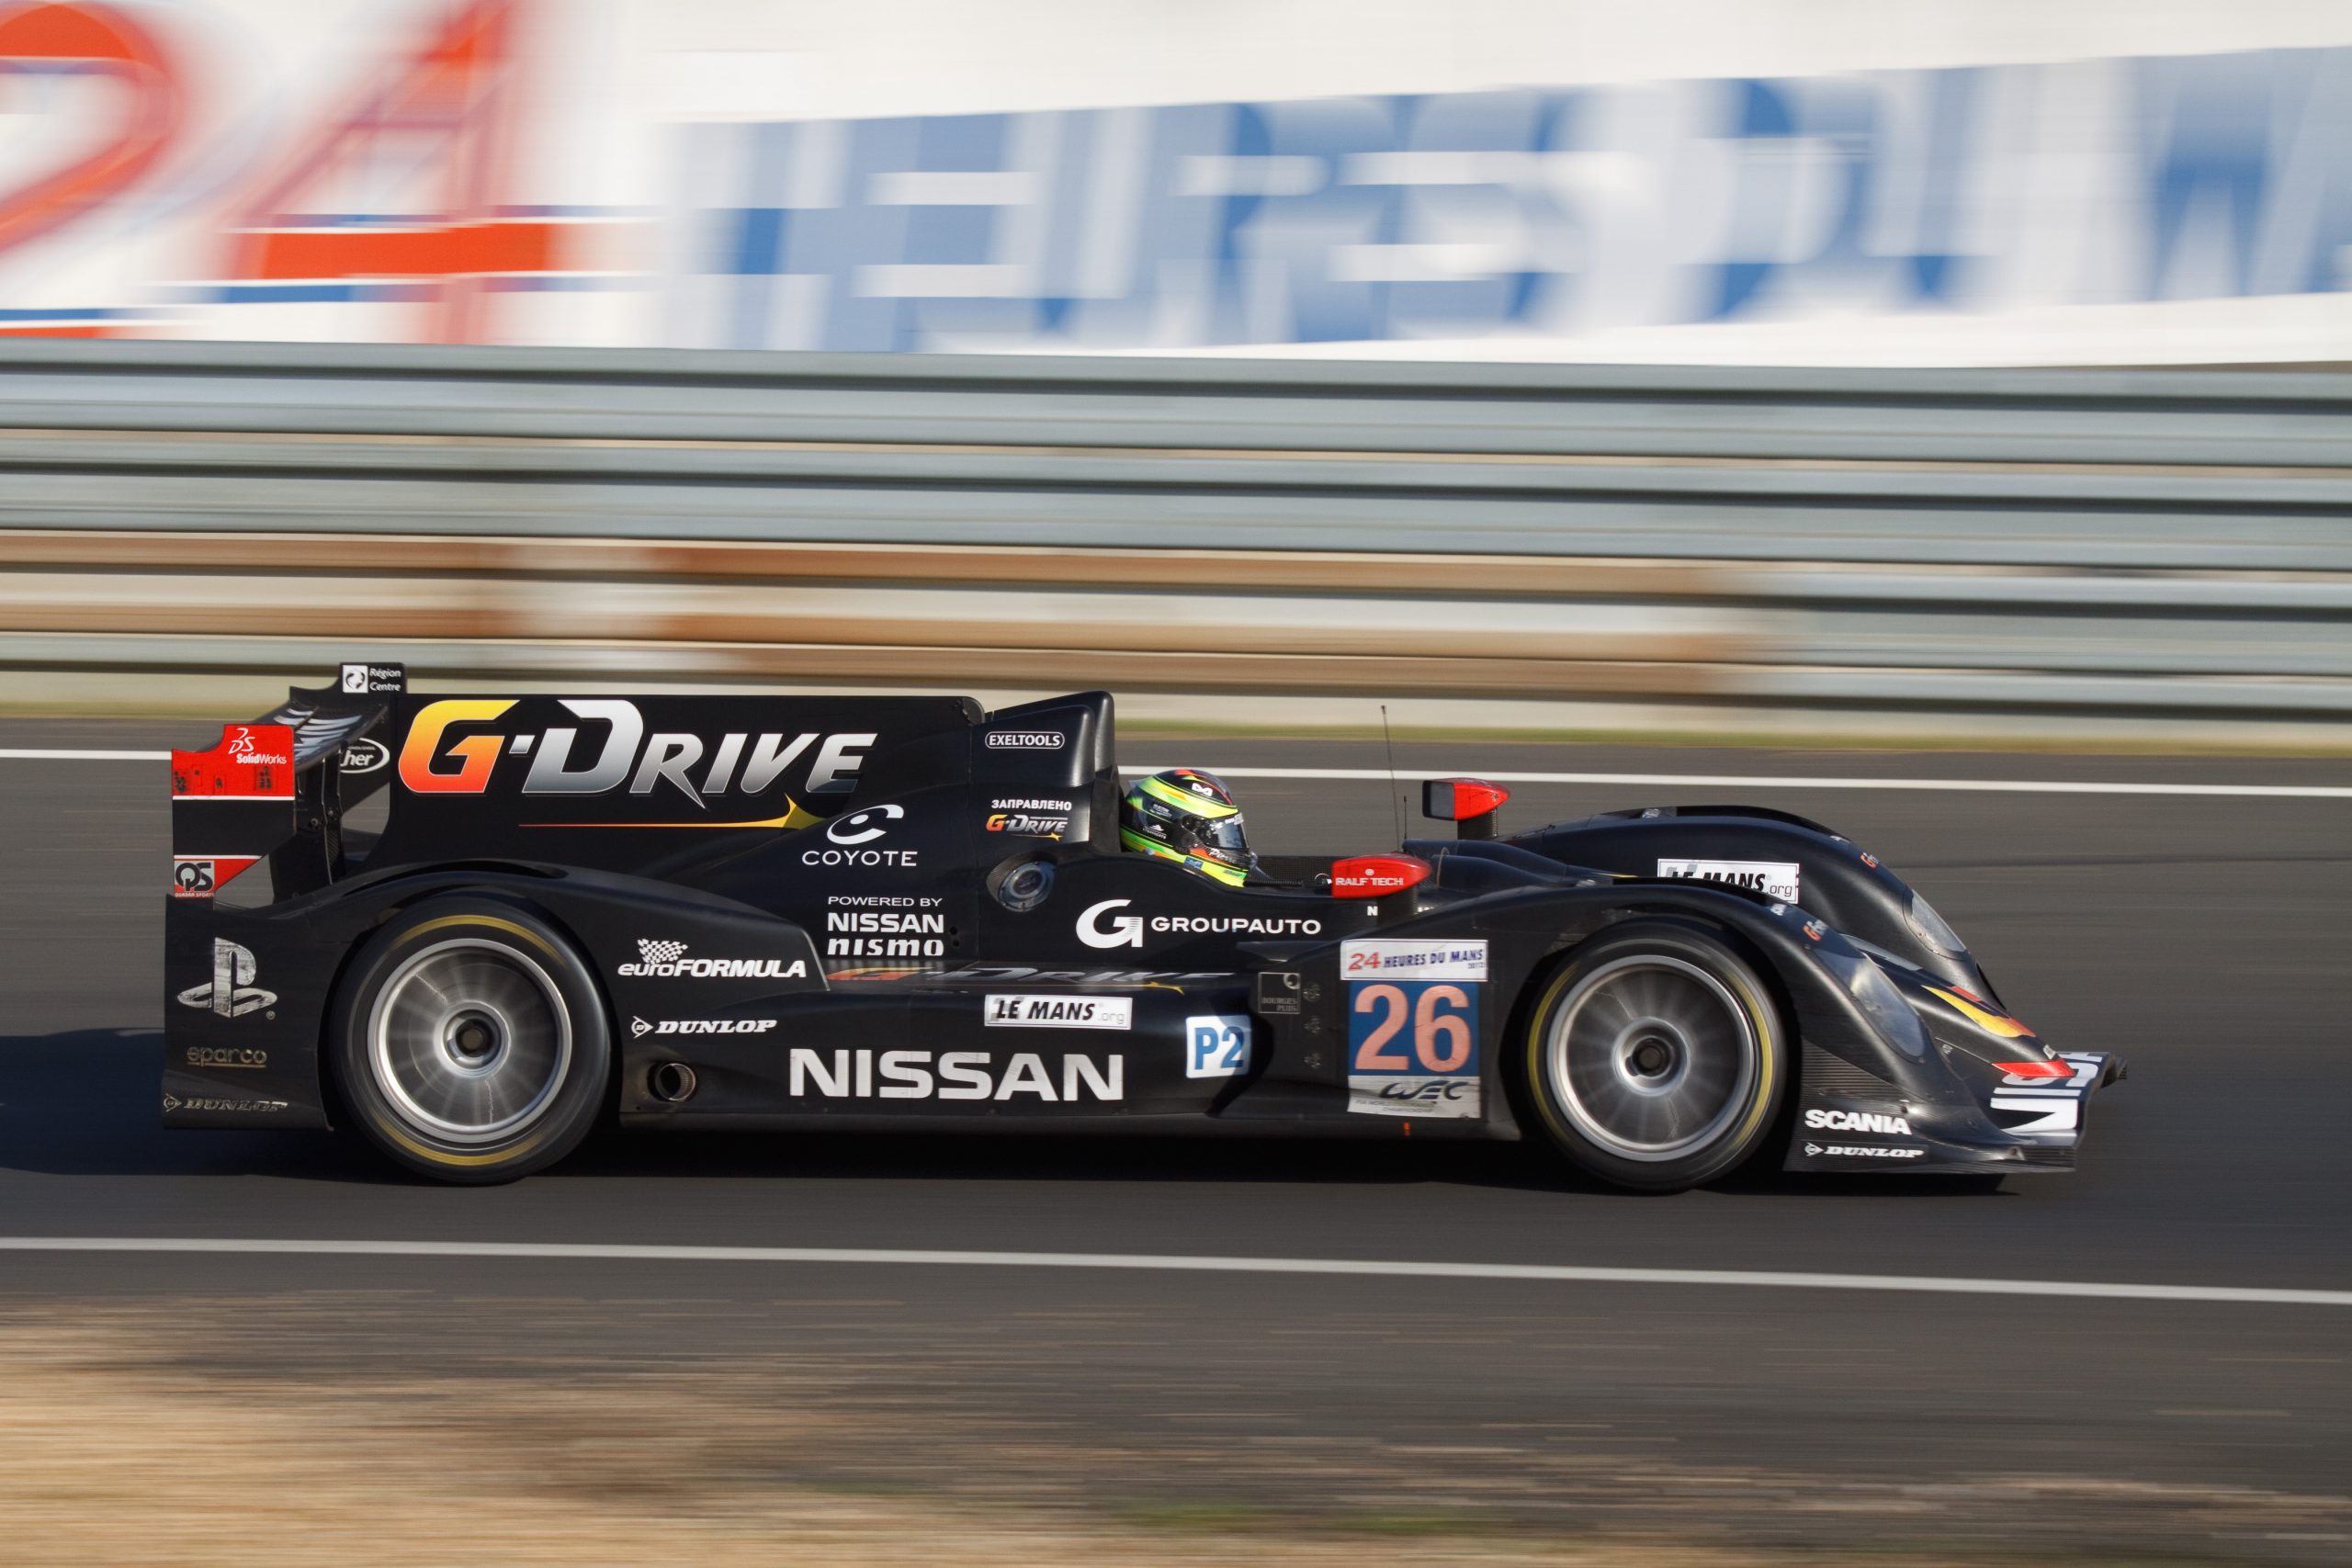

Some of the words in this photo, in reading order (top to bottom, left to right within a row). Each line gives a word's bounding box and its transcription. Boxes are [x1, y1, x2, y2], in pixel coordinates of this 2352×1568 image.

[369, 668, 401, 679] Région
[369, 682, 401, 692] Centre
[989, 735, 1060, 747] EXELTOOLS
[236, 752, 288, 764] SolidWorks
[398, 699, 878, 809] G-DRIVE
[991, 799, 1073, 811] ЗАПРАВЛЕНО
[986, 814, 1069, 834] G-DRIVE
[801, 851, 918, 867] COYOTE
[1336, 877, 1369, 886] RALF
[1370, 877, 1404, 886] TECH
[828, 896, 914, 907] POWERED
[920, 898, 943, 907] BY
[827, 912, 944, 933] NISSAN
[1151, 917, 1321, 935] GROUPAUTO
[827, 939, 944, 956] nismo
[617, 959, 807, 977] euroFORMULA
[1348, 952, 1381, 971] 24
[1384, 954, 1426, 968] HEURES
[1430, 952, 1446, 964] DU
[1450, 949, 1483, 963] MANS
[997, 1000, 1022, 1019] LE
[1027, 1001, 1095, 1021] MANS
[655, 1020, 777, 1033] DUNLOP
[1354, 984, 1470, 1073] 26
[1194, 1026, 1244, 1070] P2
[789, 1048, 1124, 1101] NISSAN
[1380, 1080, 1470, 1100] WEC
[184, 1098, 288, 1112] DUNLOP
[1804, 1109, 1912, 1135] SCANIA
[1824, 1146, 1925, 1158] DUNLOP
